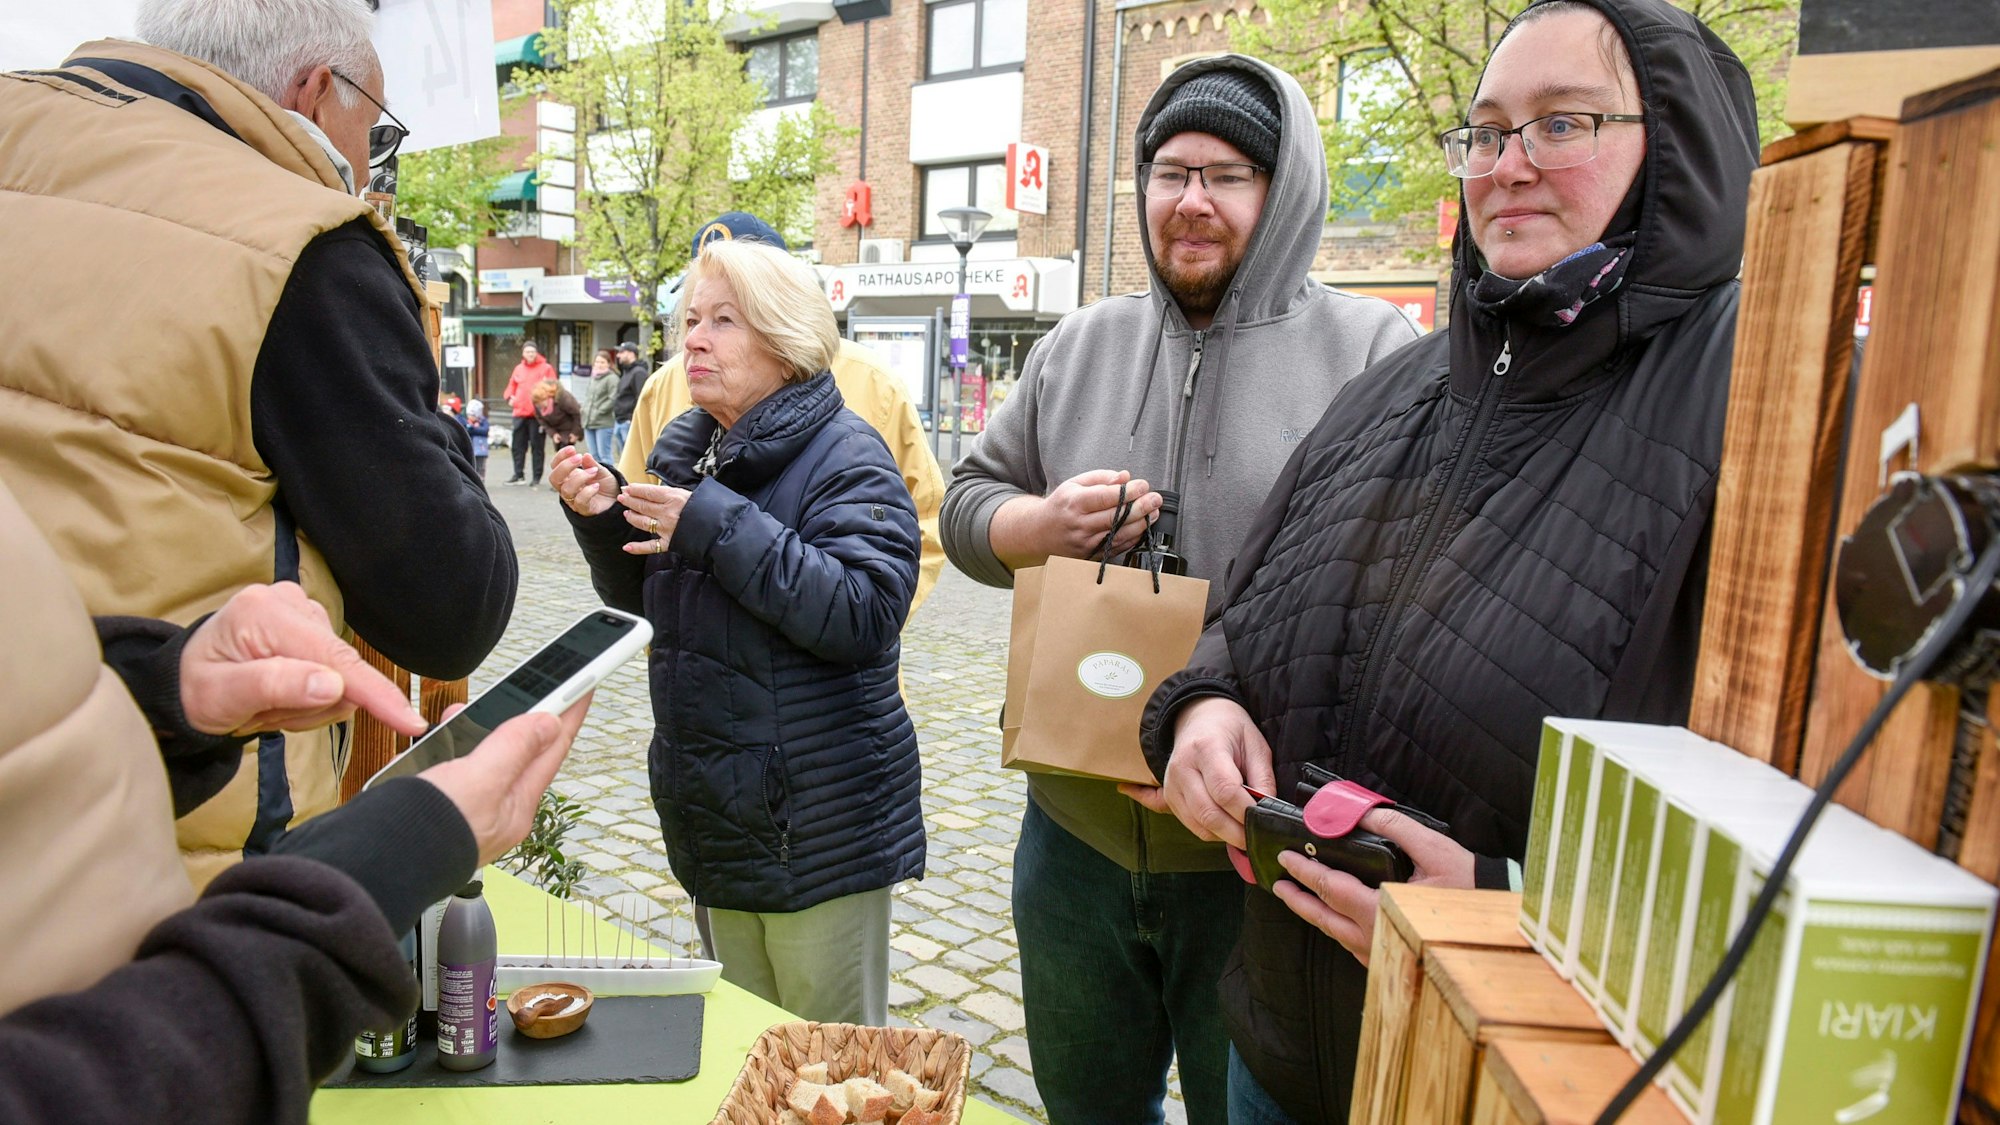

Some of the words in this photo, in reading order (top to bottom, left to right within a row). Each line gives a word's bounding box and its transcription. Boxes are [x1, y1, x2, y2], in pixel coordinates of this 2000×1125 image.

[858, 269, 1004, 287] RATHAUSAPOHEKE
[453, 350, 460, 362] 2
[1818, 999, 1938, 1041] KIARI
